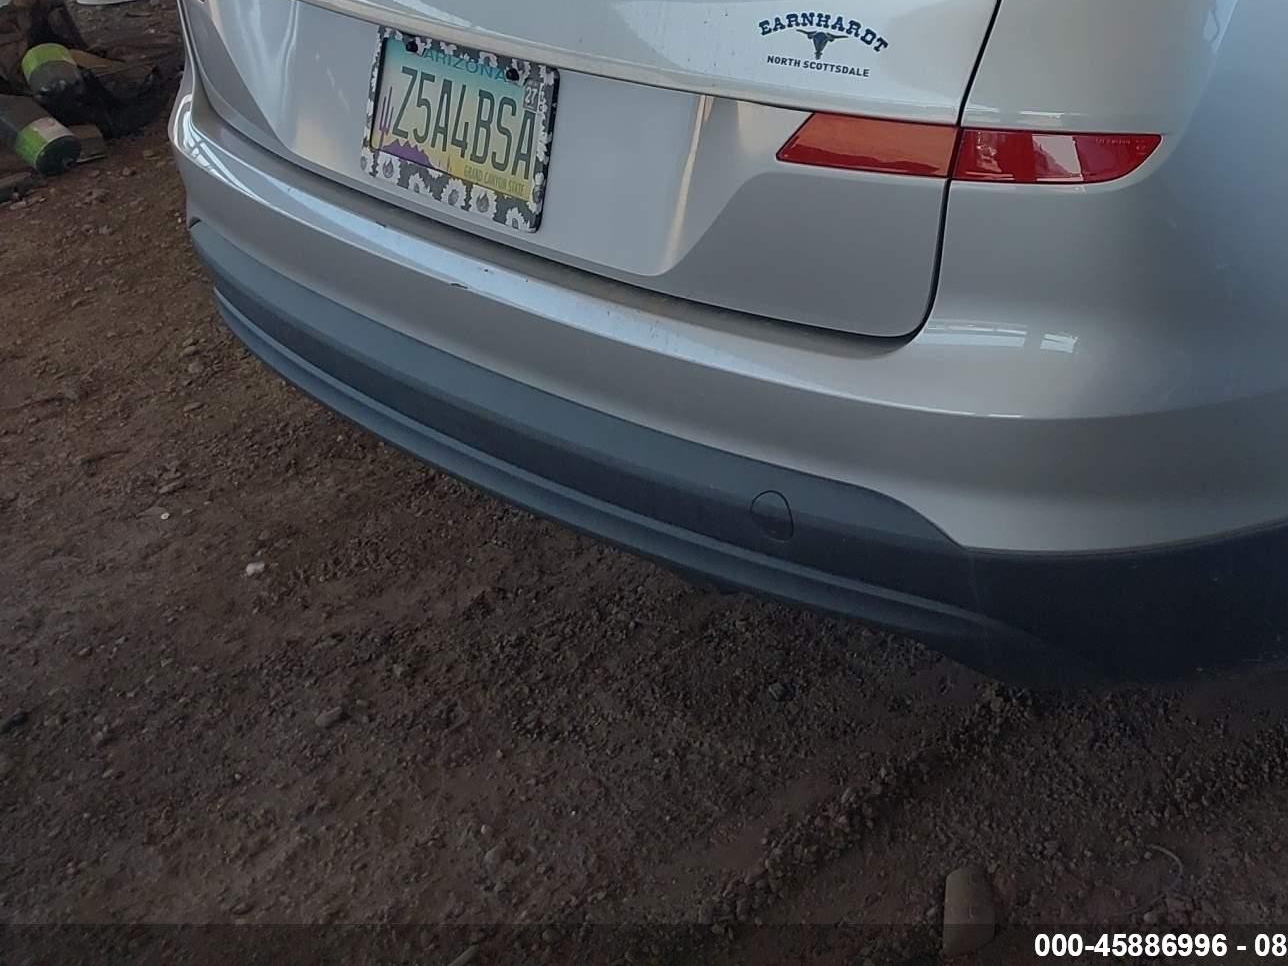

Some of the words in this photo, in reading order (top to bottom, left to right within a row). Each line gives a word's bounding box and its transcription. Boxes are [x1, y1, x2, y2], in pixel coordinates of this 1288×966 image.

[758, 12, 889, 53] EARNHARDT
[423, 48, 506, 81] ARIZONA
[767, 55, 801, 68] NORTH
[803, 60, 870, 77] SCOTTSDALE
[392, 65, 537, 180] Z5A4BSA
